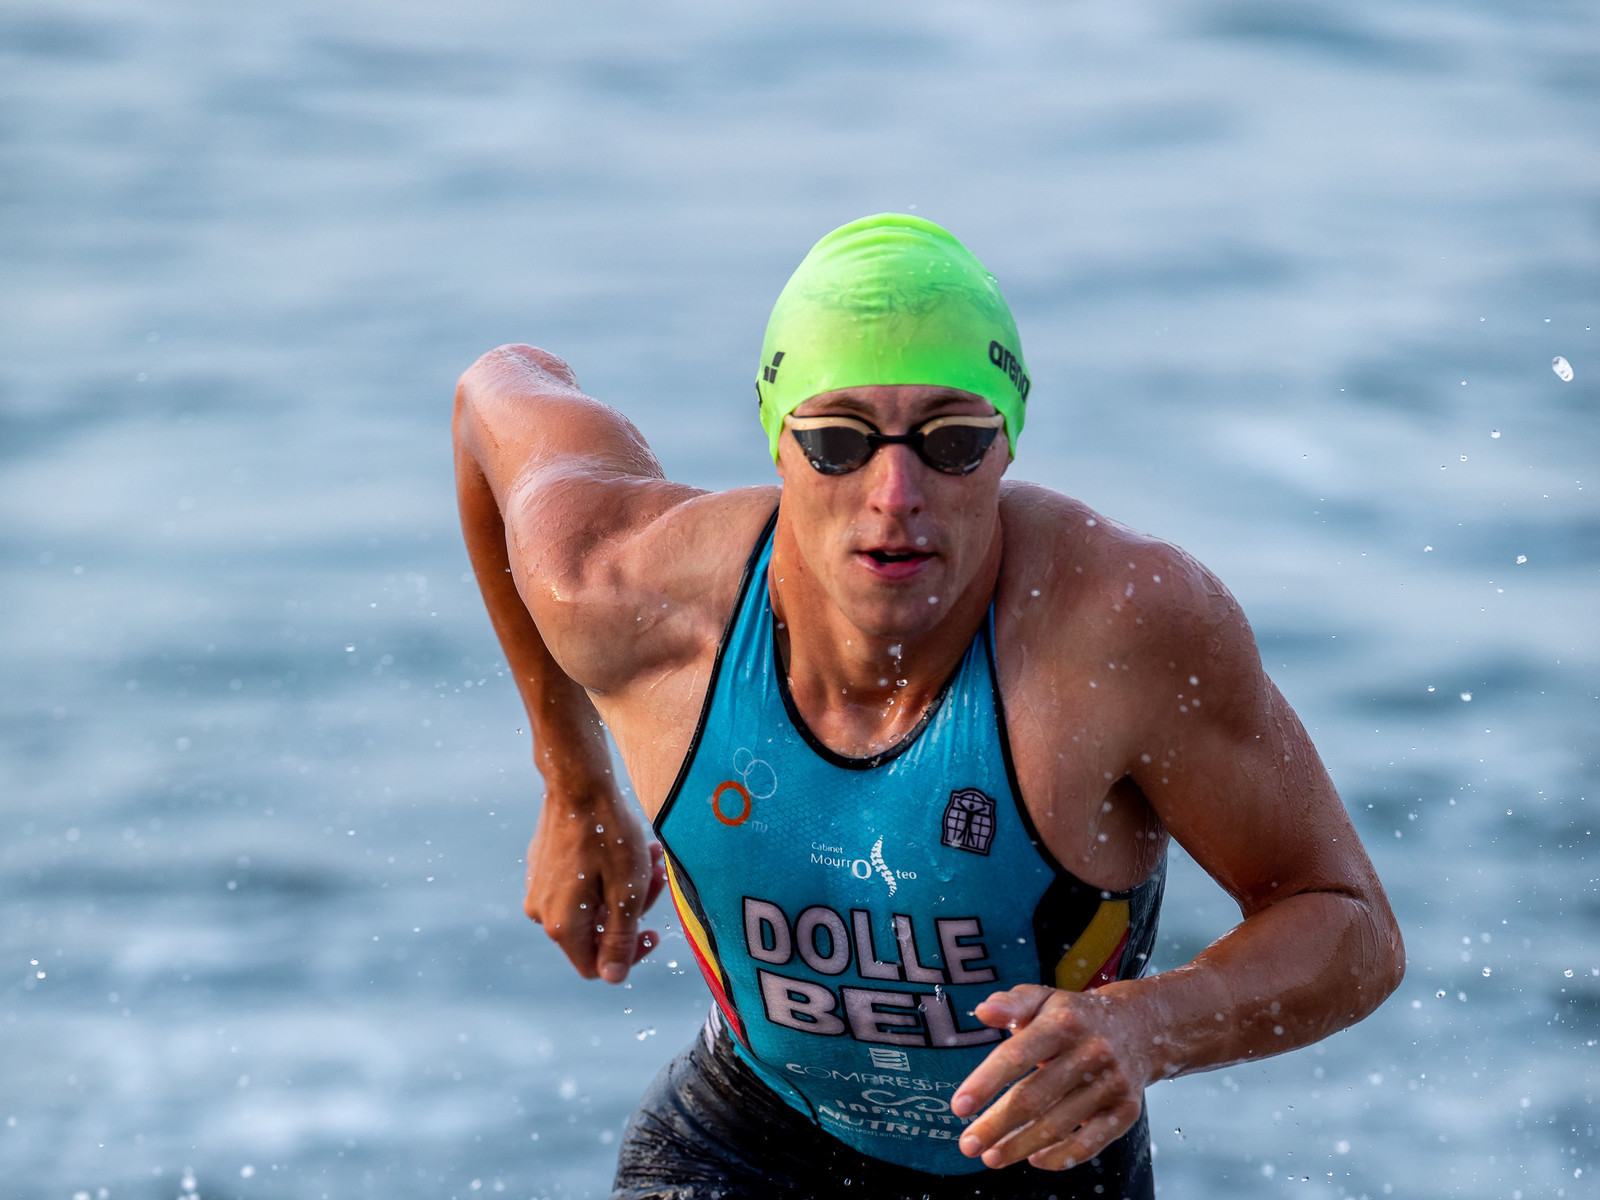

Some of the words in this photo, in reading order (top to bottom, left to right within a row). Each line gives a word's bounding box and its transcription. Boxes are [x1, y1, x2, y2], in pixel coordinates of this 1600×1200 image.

[989, 340, 1030, 403] arena
[811, 842, 843, 854] Cabinet
[742, 896, 999, 985] DOLLE
[756, 967, 1007, 1048] BEL
